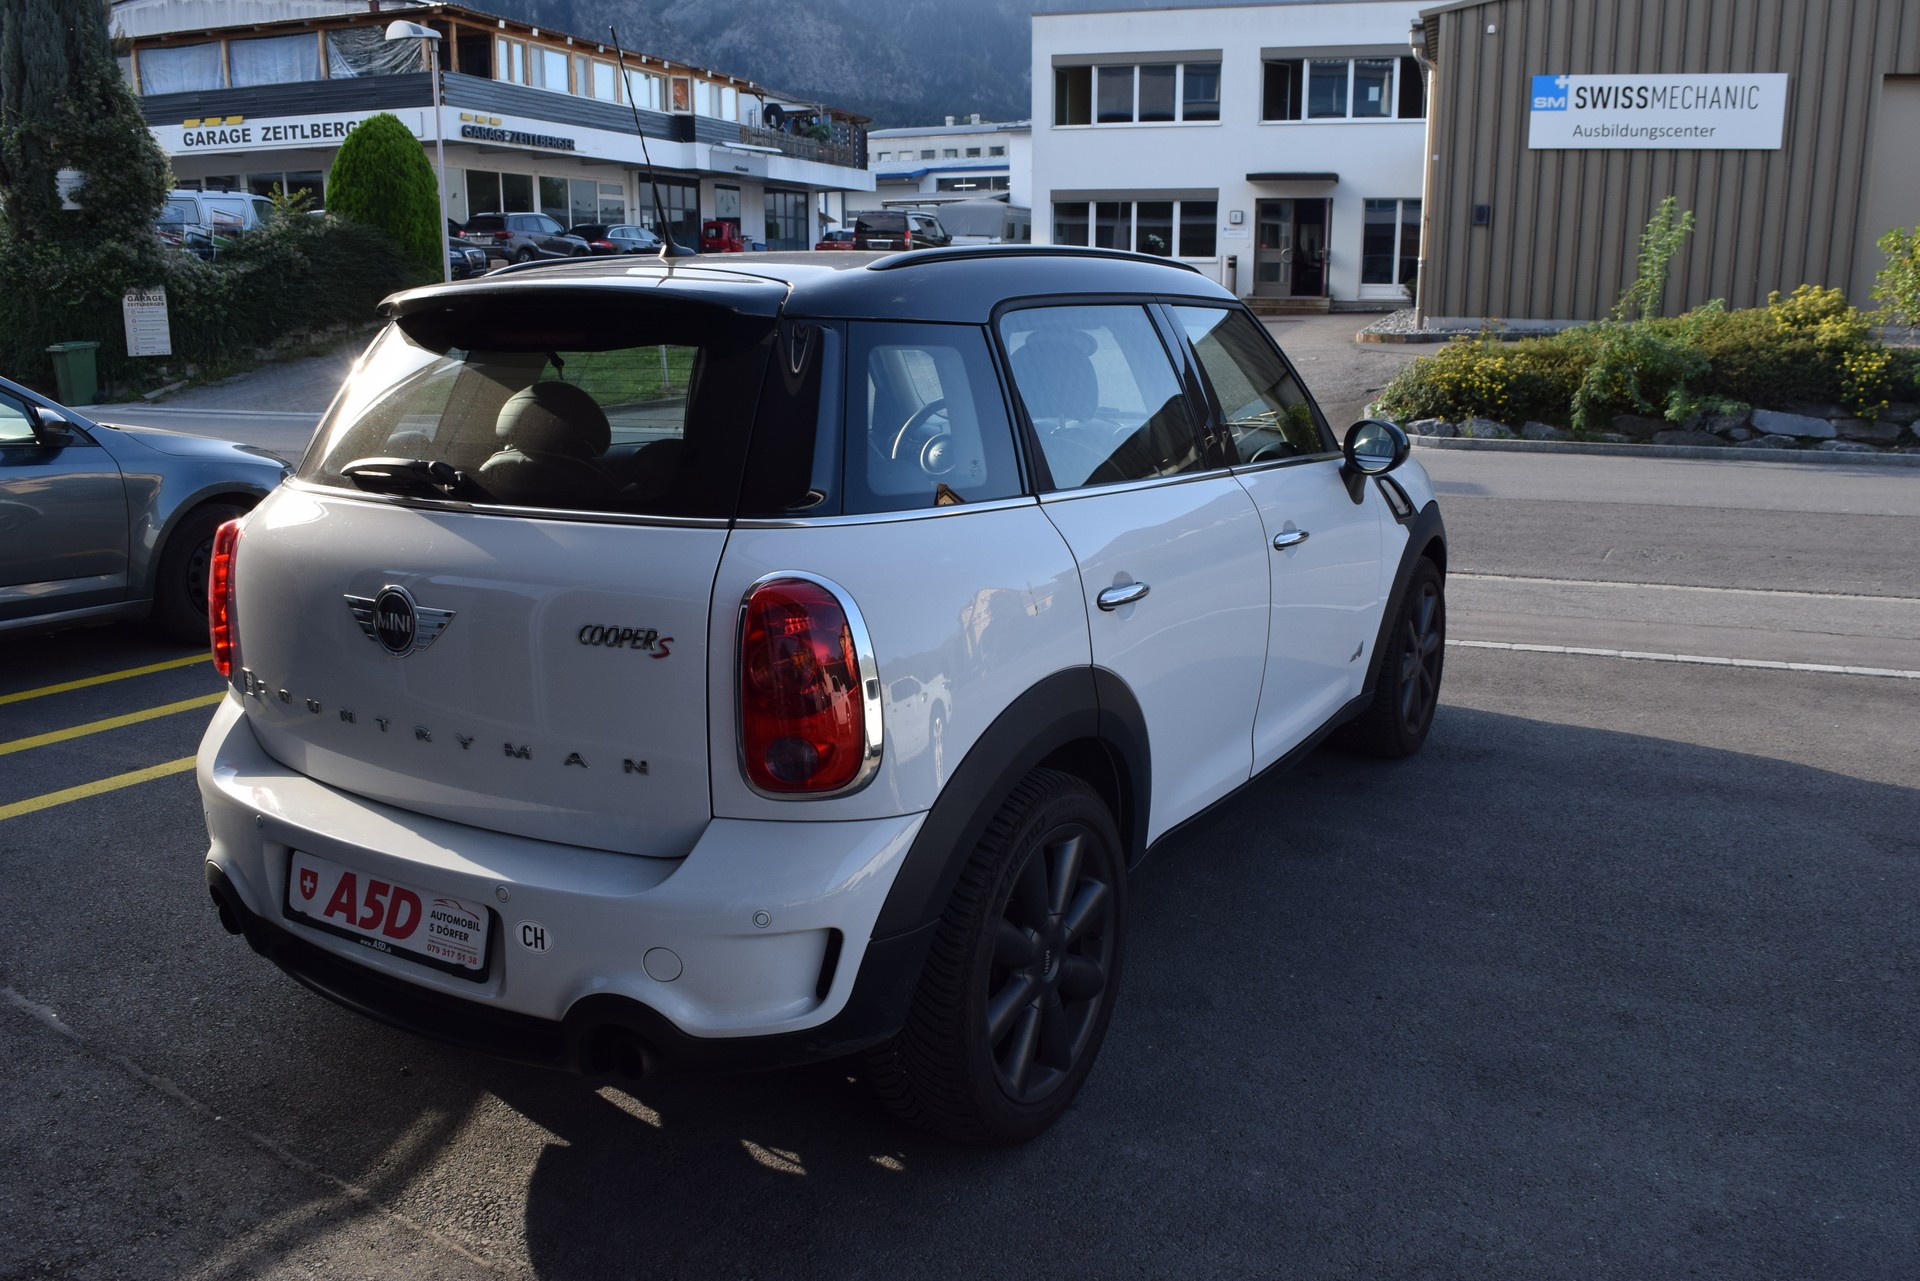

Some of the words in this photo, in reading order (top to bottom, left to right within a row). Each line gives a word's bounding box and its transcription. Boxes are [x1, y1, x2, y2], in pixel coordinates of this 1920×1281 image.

[1533, 97, 1566, 108] SM
[1574, 85, 1760, 110] SWISSMECHANIC
[183, 128, 252, 147] GARAGE
[461, 125, 511, 142] GARAGE
[510, 131, 576, 151] ZEITLBERGER
[1572, 125, 1716, 140] Ausbildungscenter
[377, 611, 411, 633] MINI
[579, 625, 659, 650] COOPER
[650, 637, 674, 659] S
[323, 871, 423, 940] A5D
[430, 910, 481, 932] AUTOMOBIL
[429, 923, 434, 932] 5
[438, 924, 469, 942] DÖRFER
[522, 925, 545, 950] CH
[442, 948, 455, 958] 317
[457, 953, 466, 961] 51
